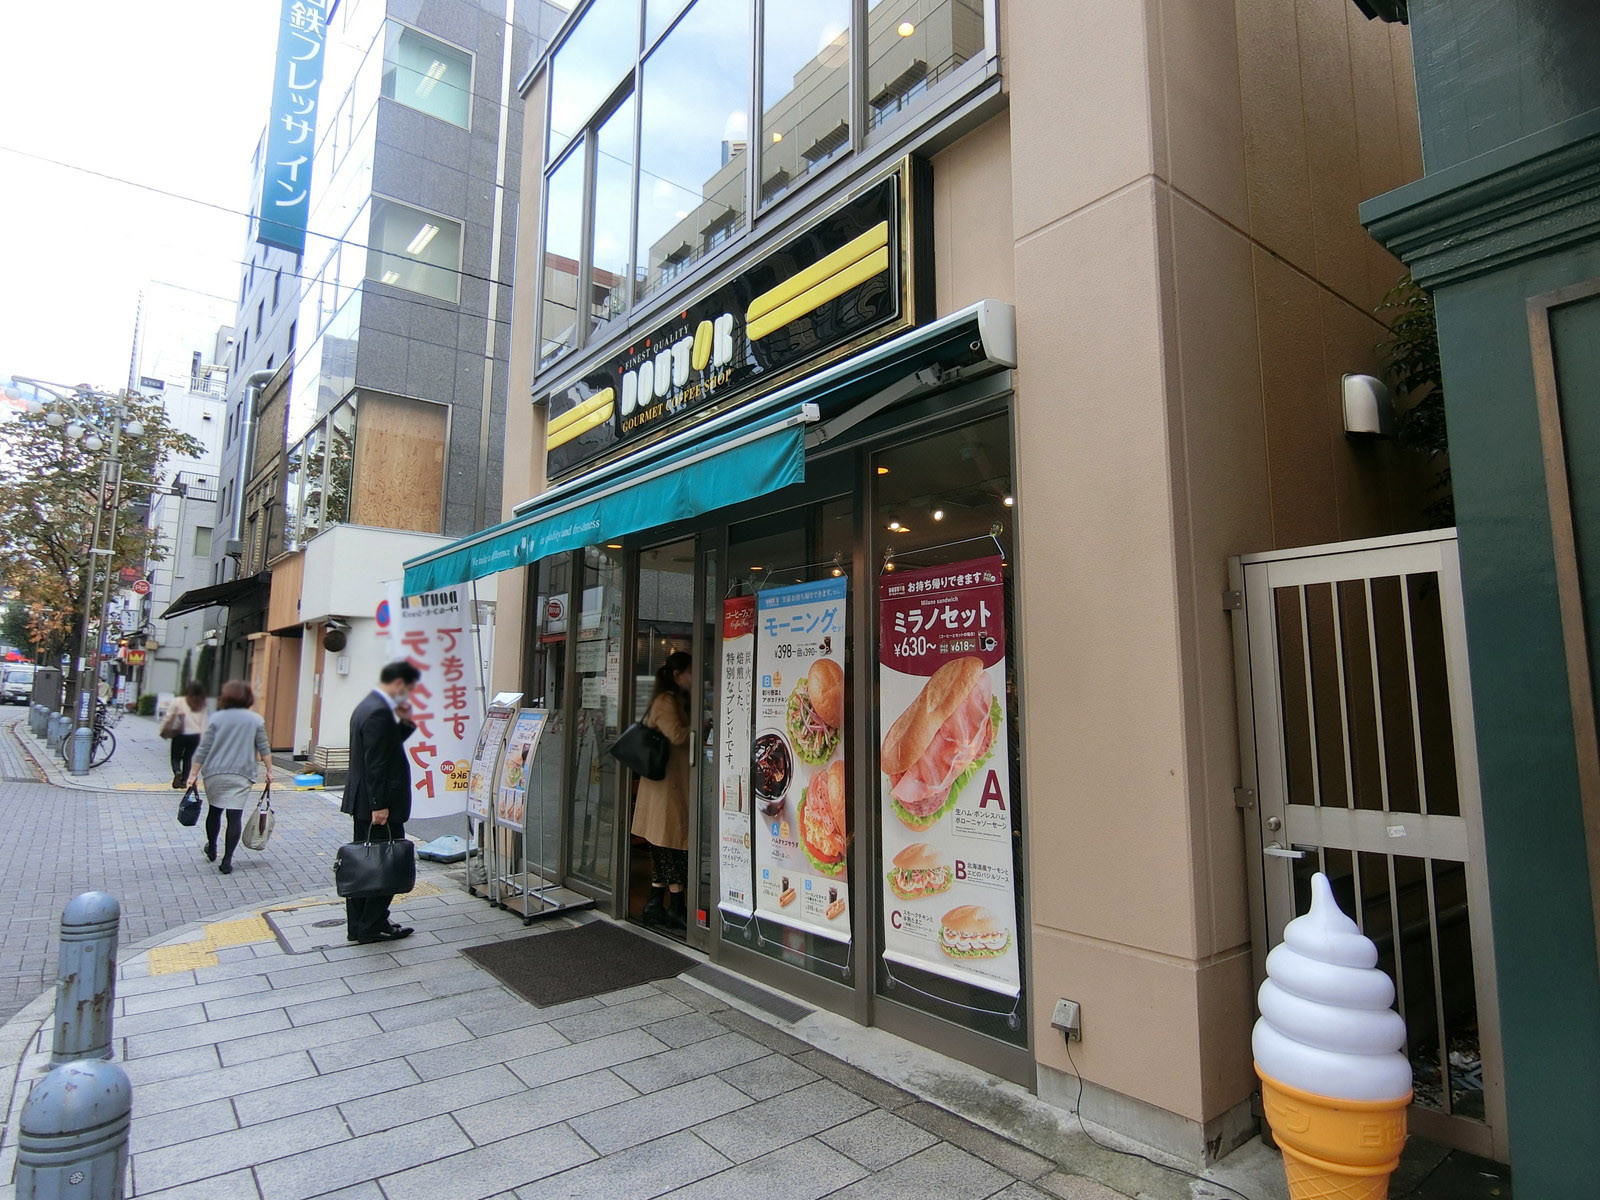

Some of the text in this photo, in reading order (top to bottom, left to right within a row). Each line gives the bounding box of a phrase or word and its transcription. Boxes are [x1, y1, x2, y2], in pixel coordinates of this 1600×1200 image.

[275, 0, 326, 207] 鉄フレッサイン
[621, 312, 734, 416] DOUTOR
[625, 323, 690, 371] FINEST QUALITY
[622, 368, 733, 433] GOURMET COFFEE SHOP
[907, 571, 982, 593] お持ち帰りできます
[894, 600, 992, 634] ミラノセット
[936, 596, 959, 604] sandwich
[764, 607, 838, 637] モーニング
[764, 676, 770, 687] B
[725, 652, 735, 771] 特別なブレンドです。
[978, 768, 1006, 811] A
[955, 859, 968, 880] B
[891, 910, 902, 929] C
